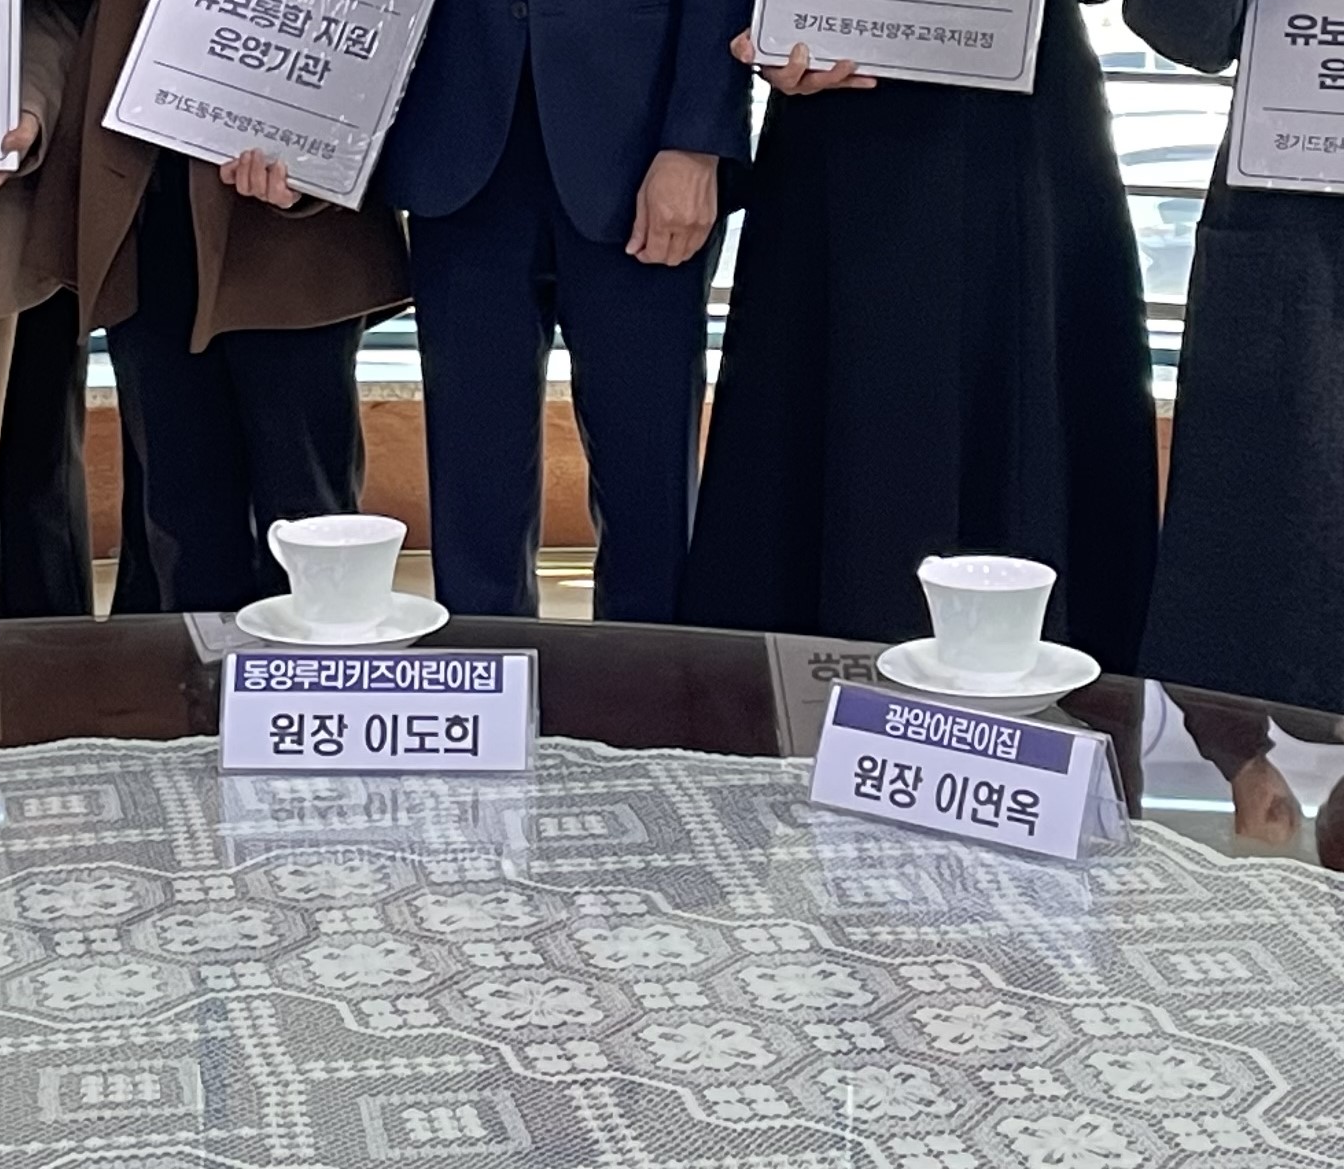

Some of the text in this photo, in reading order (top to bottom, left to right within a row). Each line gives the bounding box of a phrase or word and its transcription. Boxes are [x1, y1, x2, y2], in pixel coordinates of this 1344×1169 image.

[314, 15, 379, 60] 지원
[793, 13, 994, 48] 경기도동두천양주교육지원청
[208, 26, 332, 90] 운영기관
[243, 659, 496, 691] 동양루리키즈어린이집
[269, 713, 480, 757] 원장 이도희
[885, 703, 1022, 760] 광암어린이집
[854, 755, 1041, 836] 원장 이연옥
